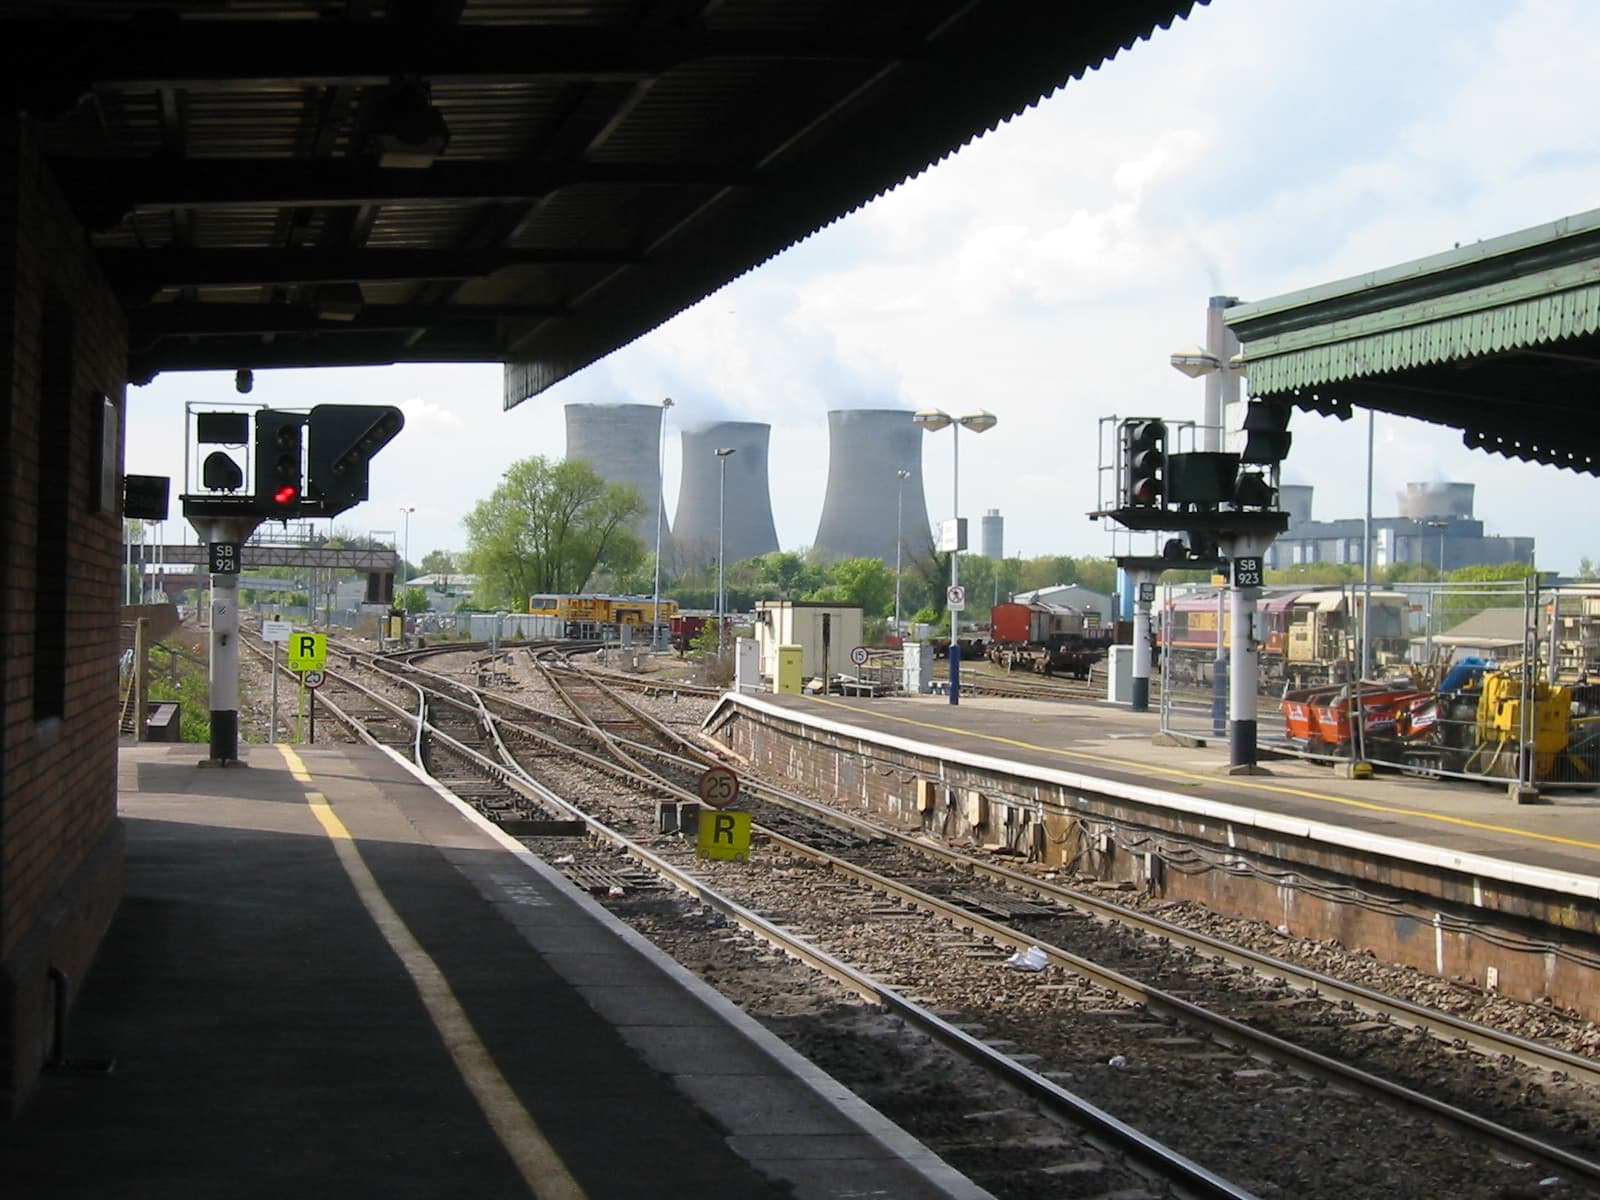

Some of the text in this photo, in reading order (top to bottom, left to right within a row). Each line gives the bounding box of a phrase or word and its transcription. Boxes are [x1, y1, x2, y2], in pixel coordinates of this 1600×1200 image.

[216, 545, 233, 557] SB
[216, 560, 234, 570] 921
[1240, 560, 1256, 570] SB
[1239, 573, 1259, 584] 923
[301, 636, 315, 657] R
[855, 650, 865, 661] 15
[707, 776, 731, 798] 25
[713, 815, 736, 844] R
